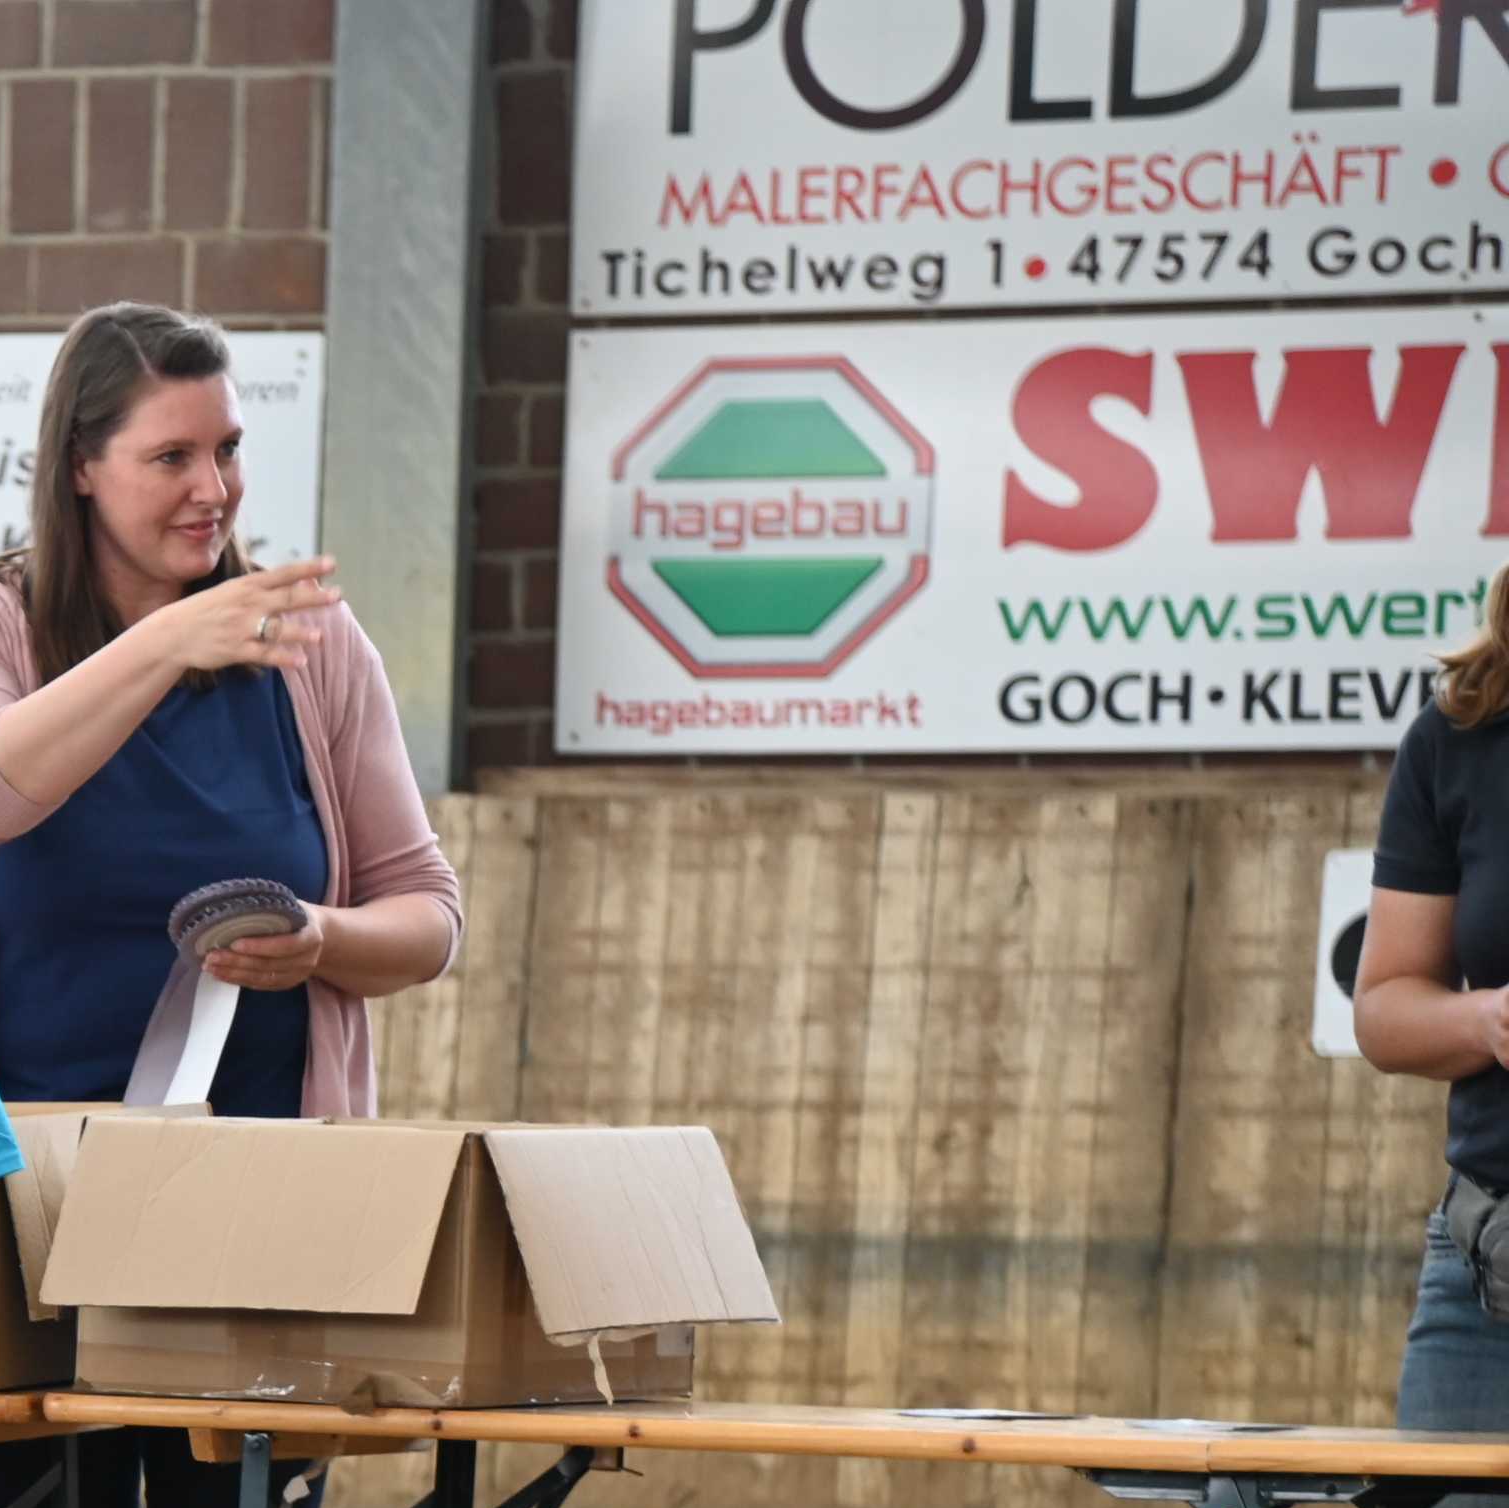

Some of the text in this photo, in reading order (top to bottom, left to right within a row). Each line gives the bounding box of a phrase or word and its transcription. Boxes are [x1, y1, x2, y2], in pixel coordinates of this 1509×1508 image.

[657, 134, 1402, 229] MALERFACHGESCHÄFT
[600, 244, 949, 302] Tichelweg
[1307, 220, 1502, 278] Goch
[1001, 340, 1509, 554] SW
[633, 488, 908, 550] hagebau
[595, 691, 922, 734] hagebaumarkt
[997, 670, 1192, 725] GOCH
